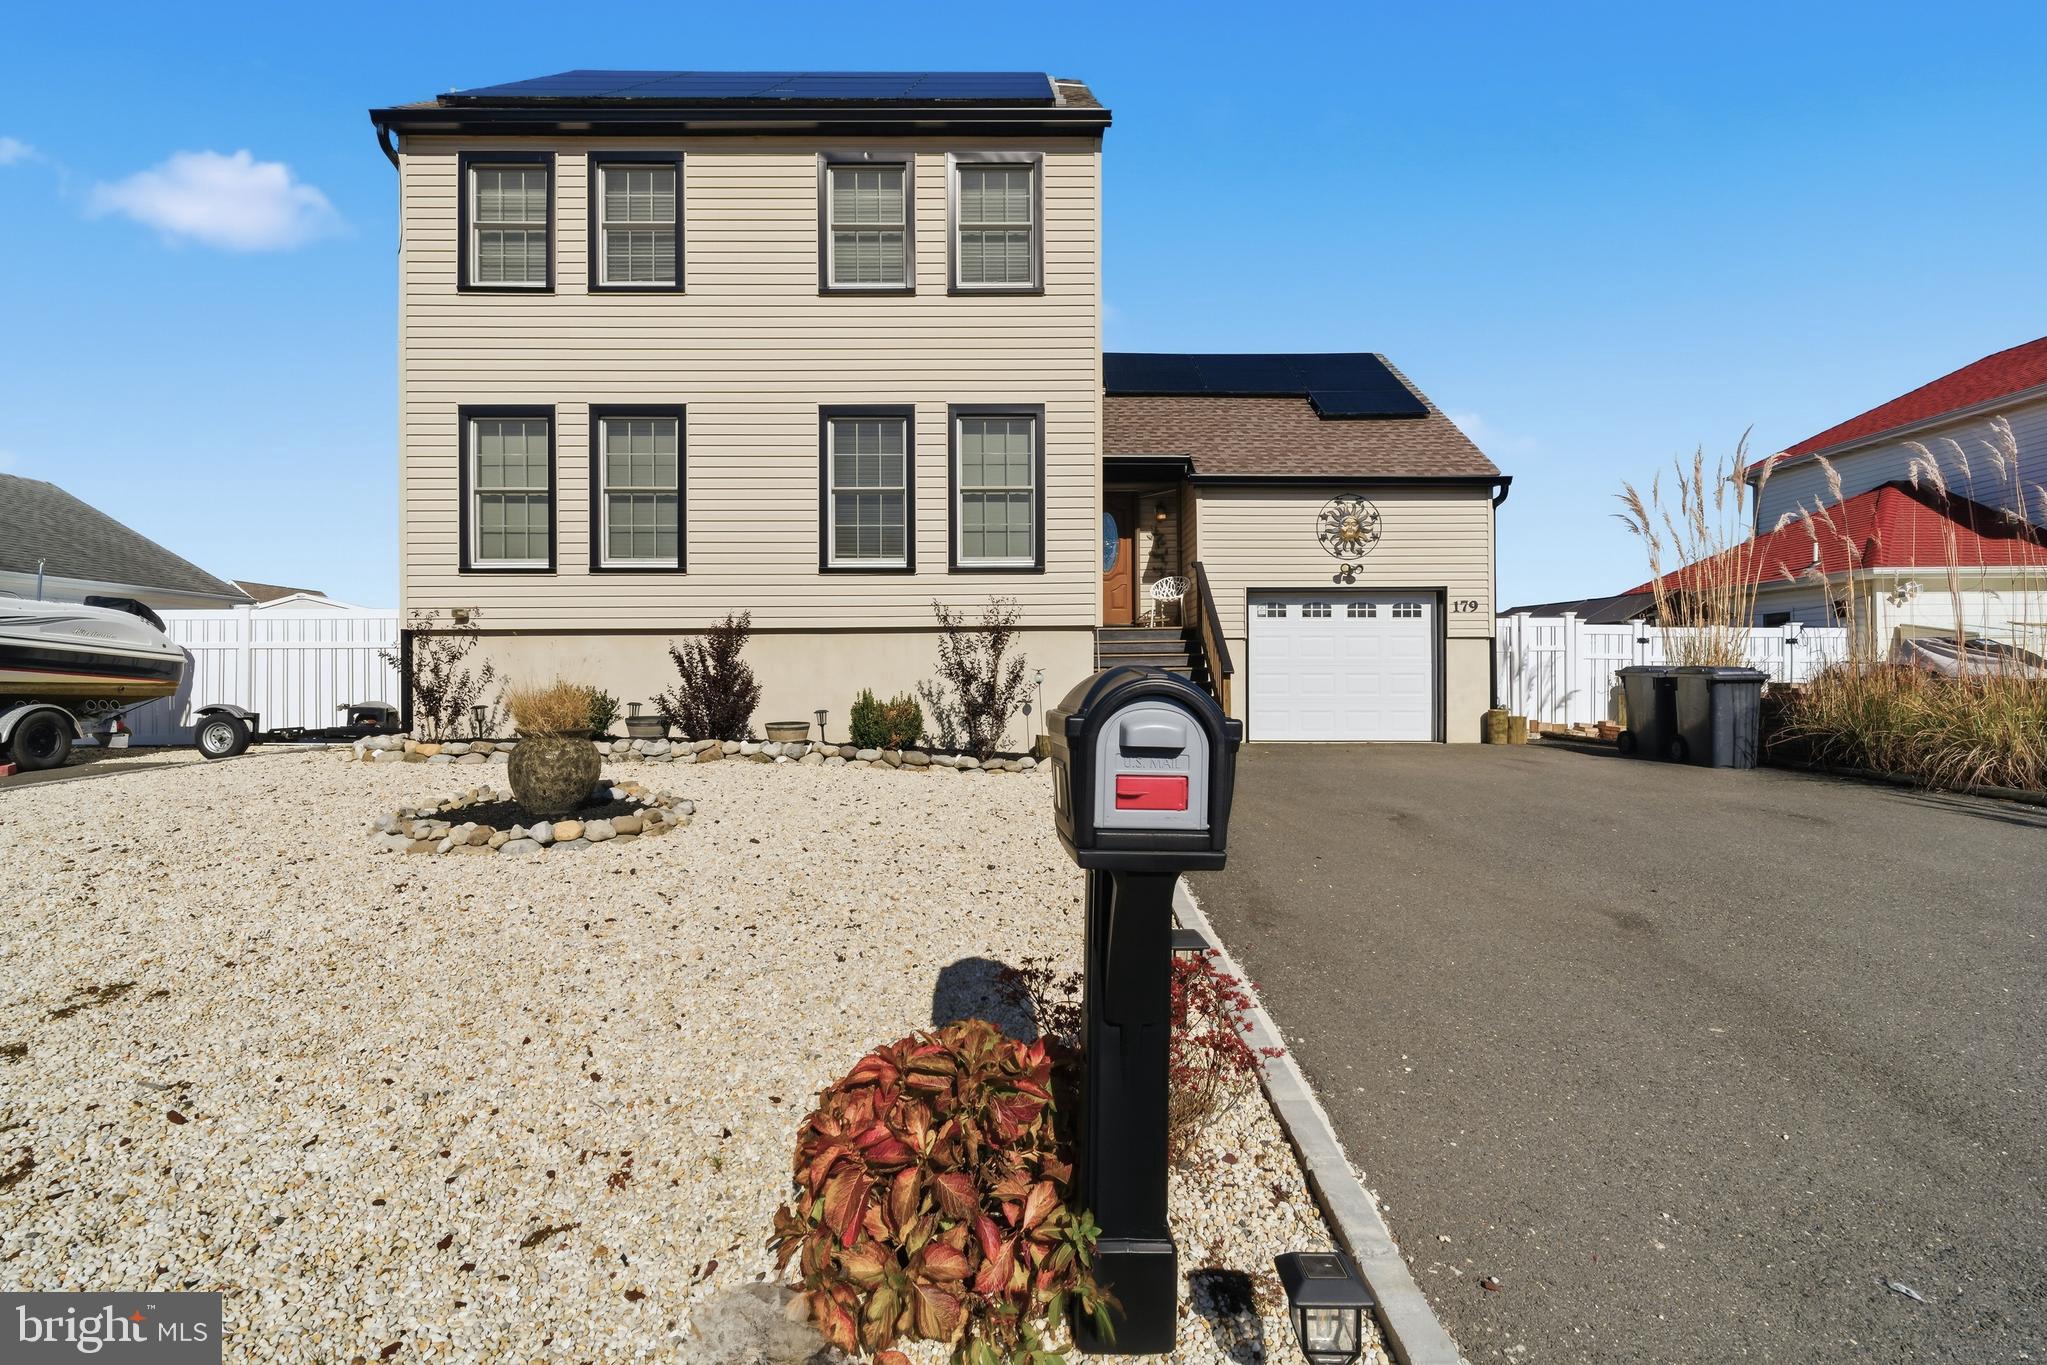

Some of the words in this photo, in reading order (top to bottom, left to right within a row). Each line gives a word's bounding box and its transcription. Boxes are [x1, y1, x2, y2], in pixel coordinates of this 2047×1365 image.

[1453, 600, 1478, 613] 179
[1123, 757, 1145, 768] U.S.
[1150, 758, 1182, 768] MAIL
